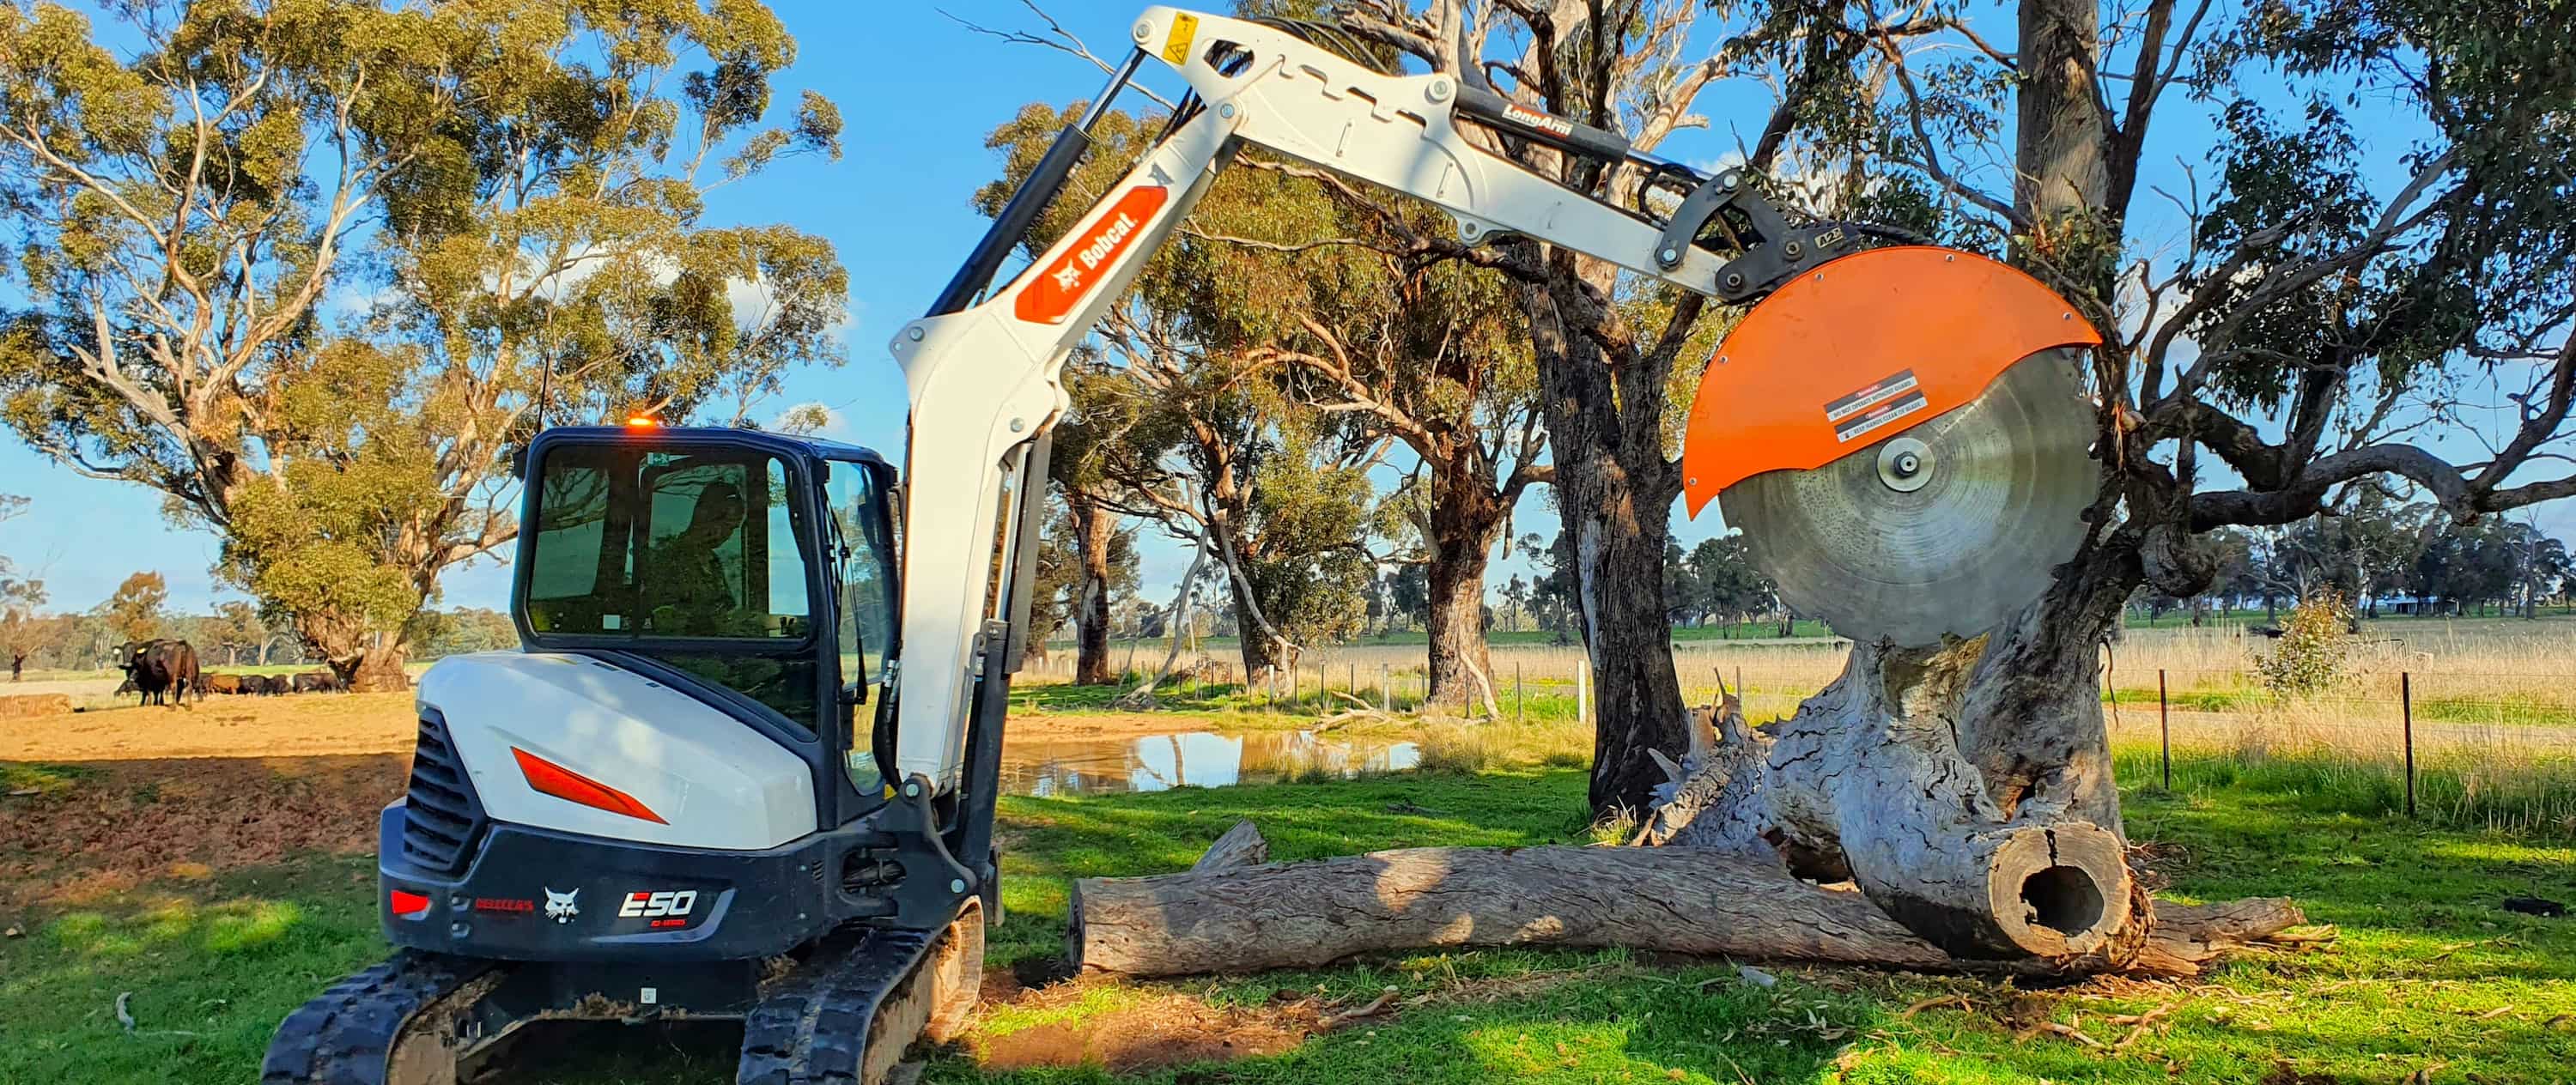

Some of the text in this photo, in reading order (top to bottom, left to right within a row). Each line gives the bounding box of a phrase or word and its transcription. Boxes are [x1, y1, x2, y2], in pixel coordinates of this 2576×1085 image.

[1502, 103, 1574, 136] LongArm
[1078, 212, 1135, 270] Bobcat
[618, 890, 697, 917] E50
